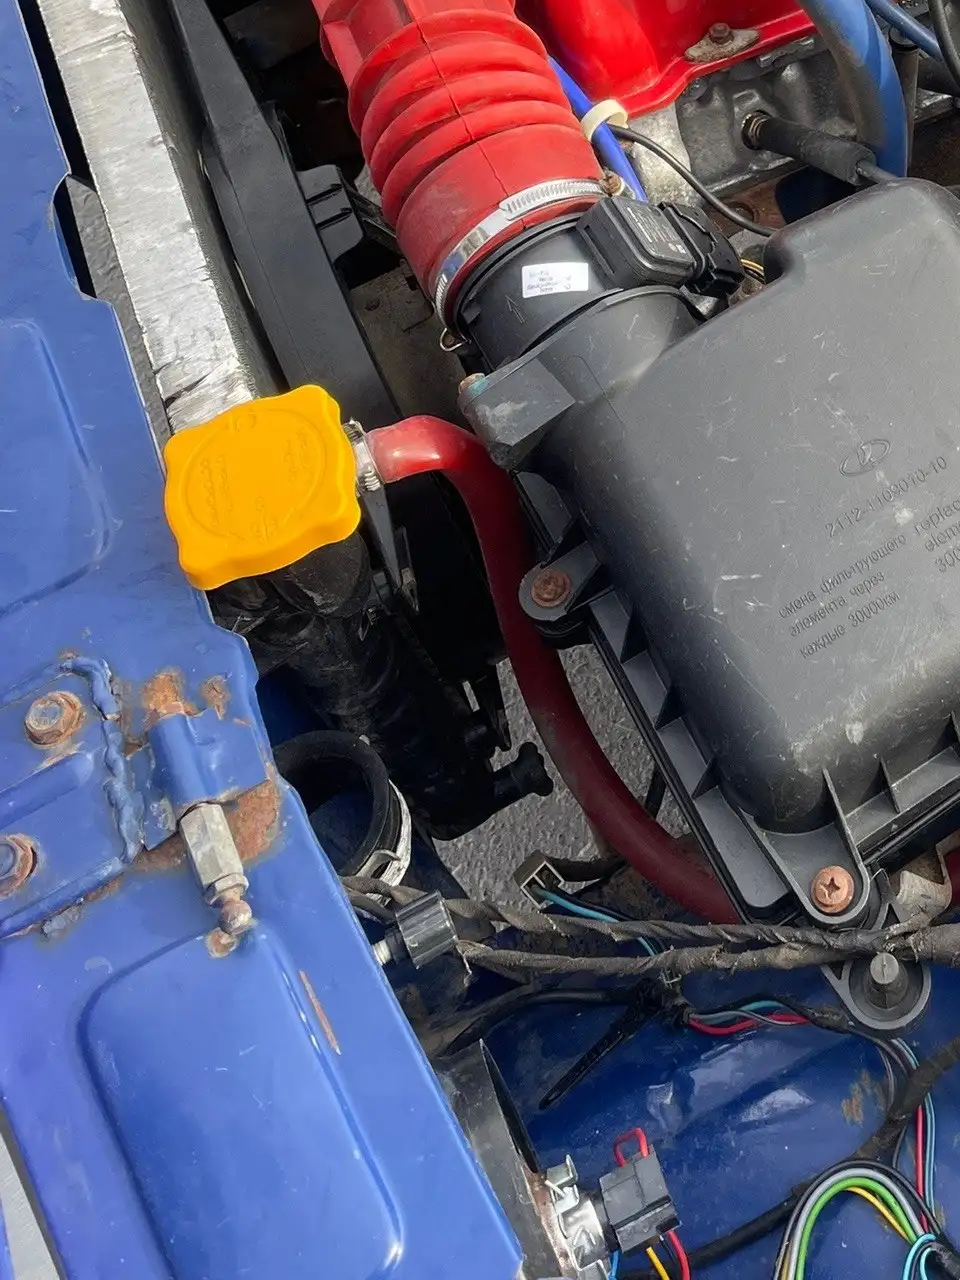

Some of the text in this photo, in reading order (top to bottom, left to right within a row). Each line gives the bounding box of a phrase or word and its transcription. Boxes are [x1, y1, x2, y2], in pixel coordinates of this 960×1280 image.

[849, 571, 885, 598] через
[779, 590, 818, 619] смена
[799, 624, 846, 660] каждые
